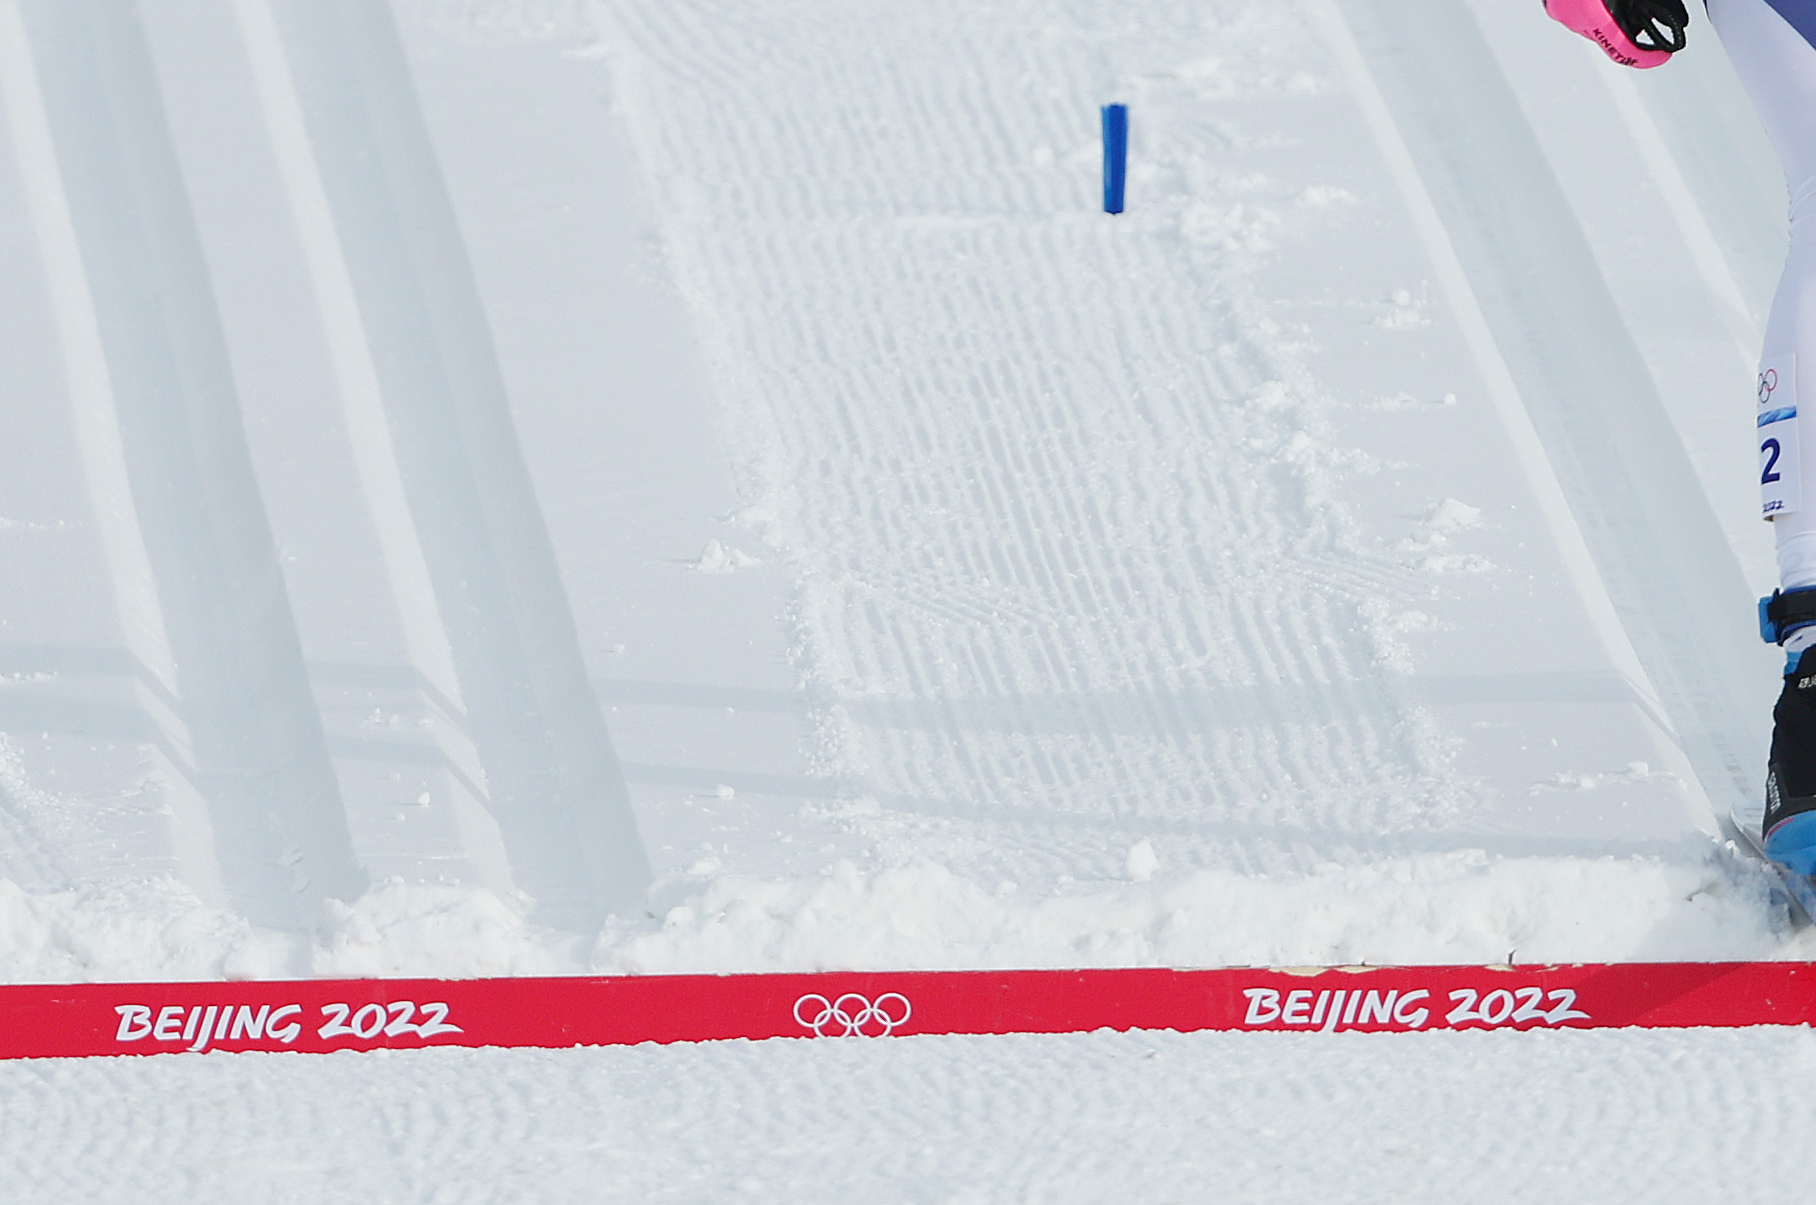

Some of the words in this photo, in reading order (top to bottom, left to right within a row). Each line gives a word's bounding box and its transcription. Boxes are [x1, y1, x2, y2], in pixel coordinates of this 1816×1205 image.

[115, 1004, 303, 1052] BEIJING
[317, 1001, 465, 1040] 2022
[1243, 988, 1430, 1032] BEIJING
[1445, 987, 1591, 1024] 2022
